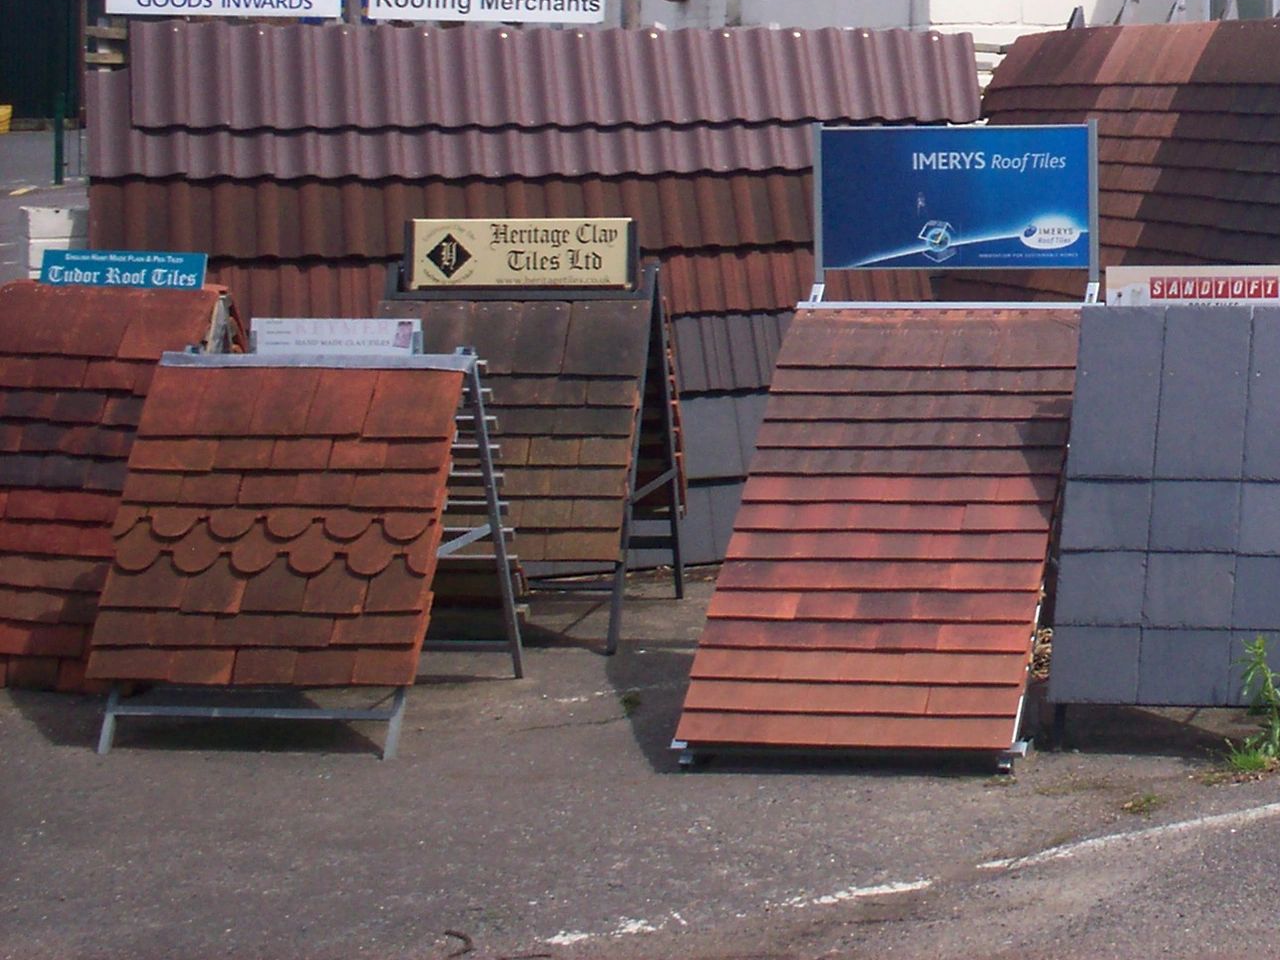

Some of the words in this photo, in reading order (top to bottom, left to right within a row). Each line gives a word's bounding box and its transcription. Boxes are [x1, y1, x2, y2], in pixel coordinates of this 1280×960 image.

[912, 151, 986, 170] IMERYS
[991, 153, 1031, 173] Roof
[1032, 153, 1067, 170] Tiles
[490, 222, 571, 250] Heritage
[576, 222, 619, 249] Clay
[507, 249, 561, 272] Tiles
[568, 248, 603, 271] Ltd
[49, 265, 101, 284] Tudor
[104, 267, 147, 285] Roof
[151, 268, 197, 287] Tiles
[1151, 278, 1279, 298] SANDTOFT
